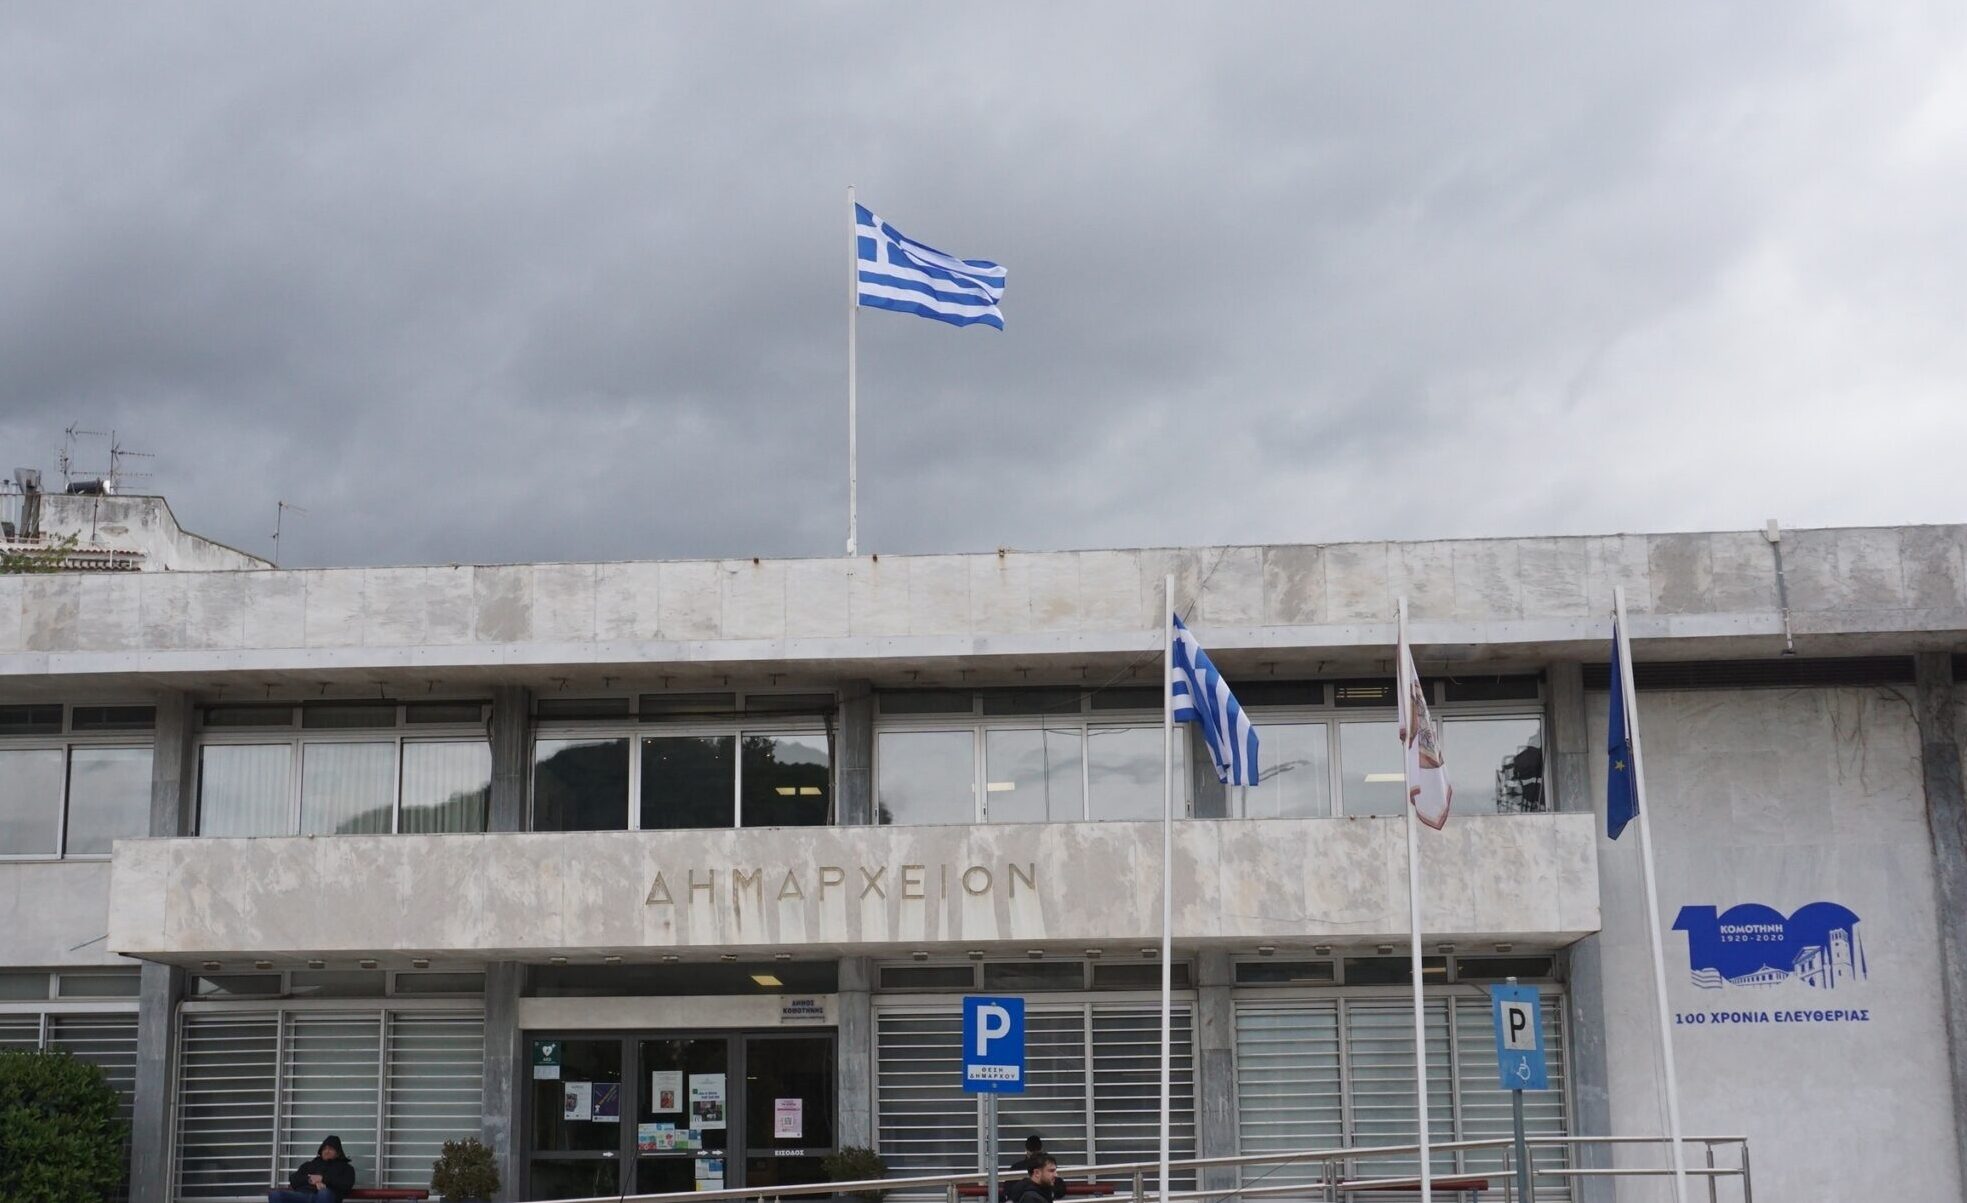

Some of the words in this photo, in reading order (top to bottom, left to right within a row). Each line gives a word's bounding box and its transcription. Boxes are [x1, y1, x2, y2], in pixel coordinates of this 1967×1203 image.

[644, 862, 1037, 906] ΔΗΜΑΡΧΕΙΟΝ
[1719, 924, 1784, 934] ΚΟΜΟΤΗΝΗ
[1508, 1007, 1526, 1043] P
[1675, 1012, 1706, 1025] 100
[1710, 1011, 1770, 1024] ΧΡΟΝΙΑ
[1774, 1009, 1870, 1022] ΕΛΕΥΘΕΡΙΑΣ
[976, 1005, 1011, 1057] P
[774, 1149, 805, 1157] ΕΙΣΟΔΟΣ
